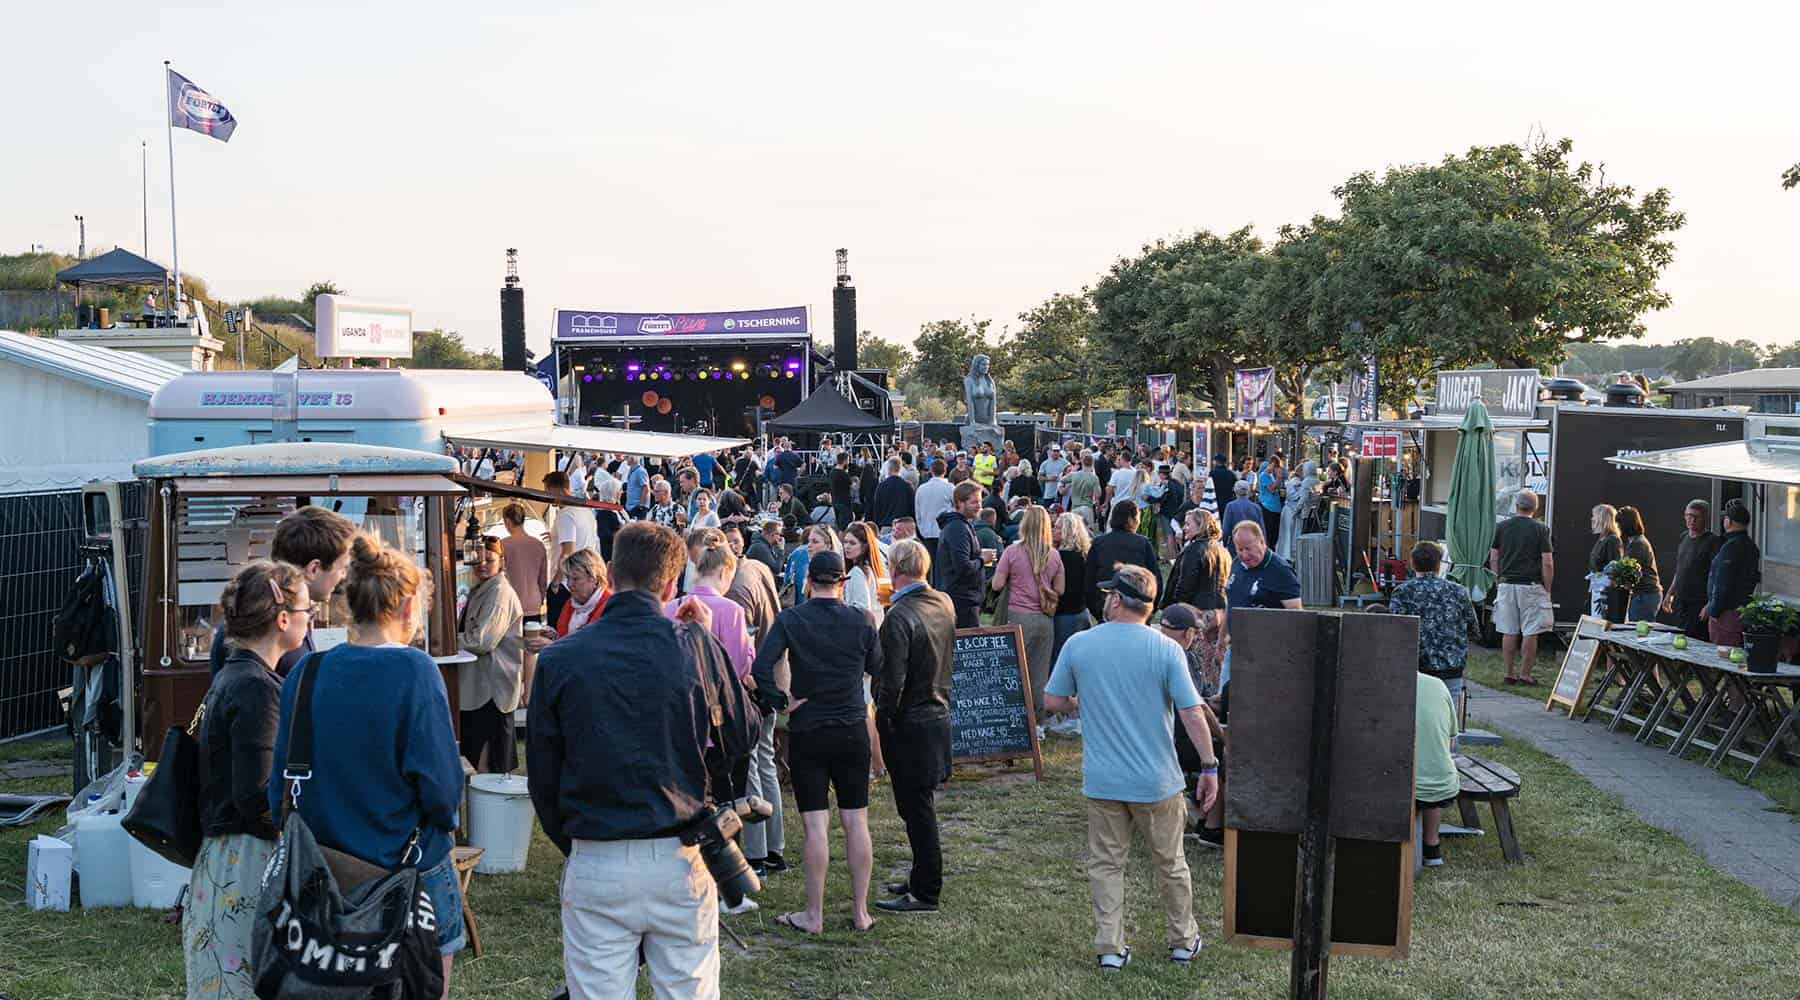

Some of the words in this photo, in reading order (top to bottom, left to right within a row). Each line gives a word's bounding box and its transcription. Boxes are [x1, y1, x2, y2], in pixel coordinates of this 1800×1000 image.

[737, 316, 800, 328] TSCHERNING
[336, 393, 353, 406] IS
[1503, 375, 1534, 412] JACK
[972, 636, 1009, 649] COFFEE
